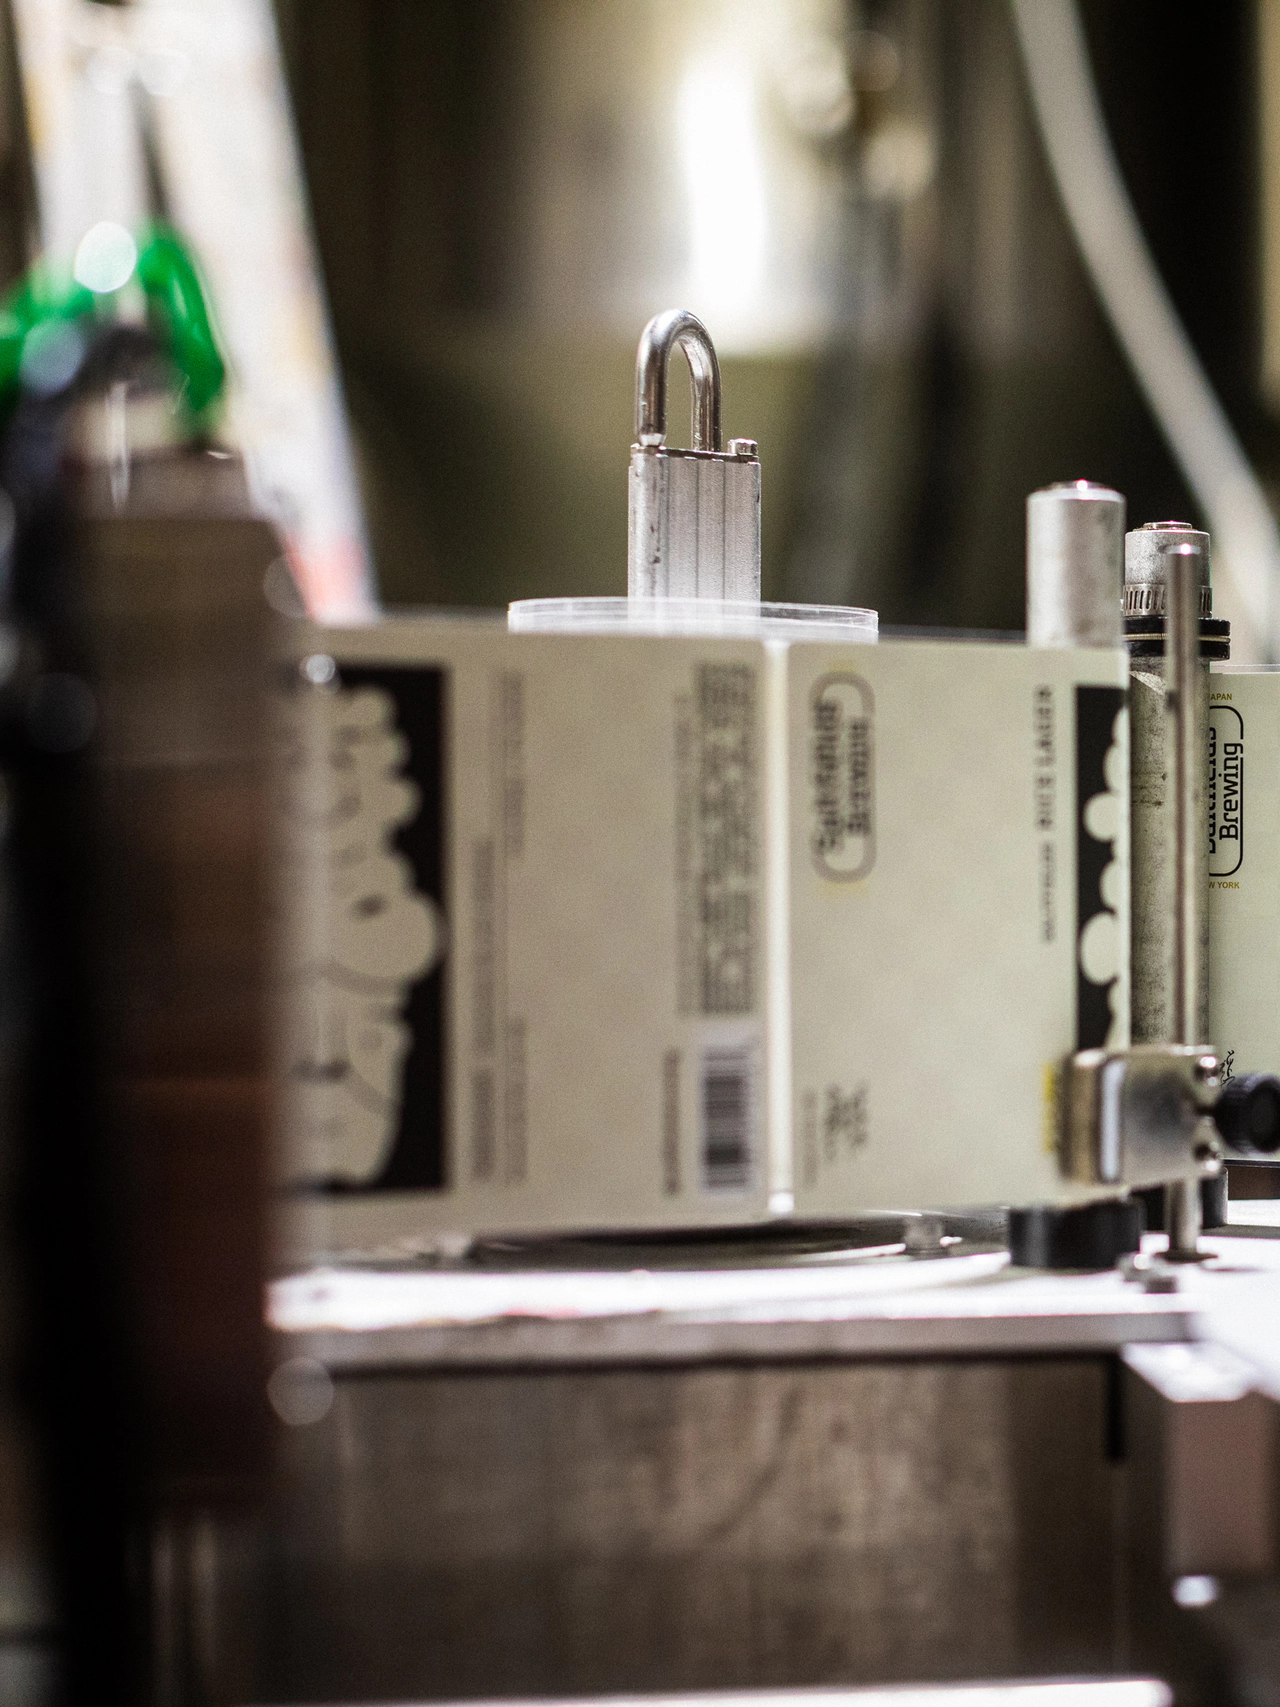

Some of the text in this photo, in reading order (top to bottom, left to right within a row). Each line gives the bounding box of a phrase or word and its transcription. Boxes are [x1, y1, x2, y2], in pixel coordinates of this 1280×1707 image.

[1210, 692, 1233, 701] APAN
[1219, 742, 1243, 841] Brewing
[1217, 881, 1240, 890] YORK
